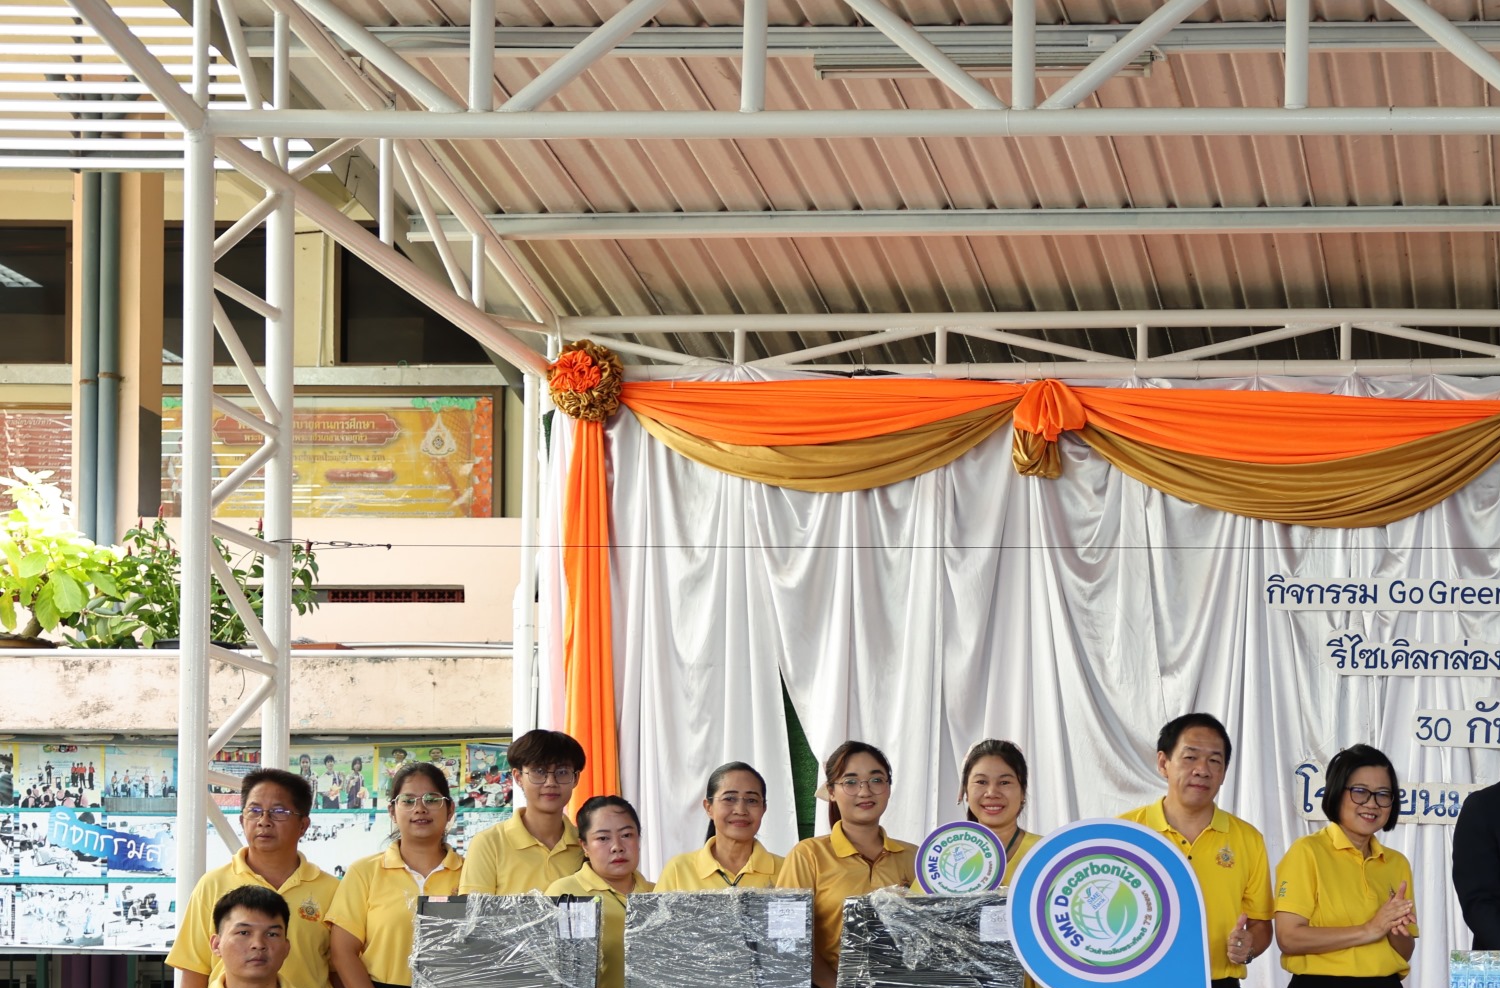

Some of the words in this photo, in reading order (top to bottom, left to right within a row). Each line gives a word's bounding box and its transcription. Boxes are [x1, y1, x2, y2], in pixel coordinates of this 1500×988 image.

[1266, 574, 1378, 605] กิจกรรม
[1415, 715, 1452, 742] 30
[932, 831, 993, 859] Decarbonize
[928, 855, 940, 880] SME
[1053, 862, 1142, 907] Decarbonize
[1054, 912, 1084, 947] SME
[1143, 913, 1153, 926] 72
